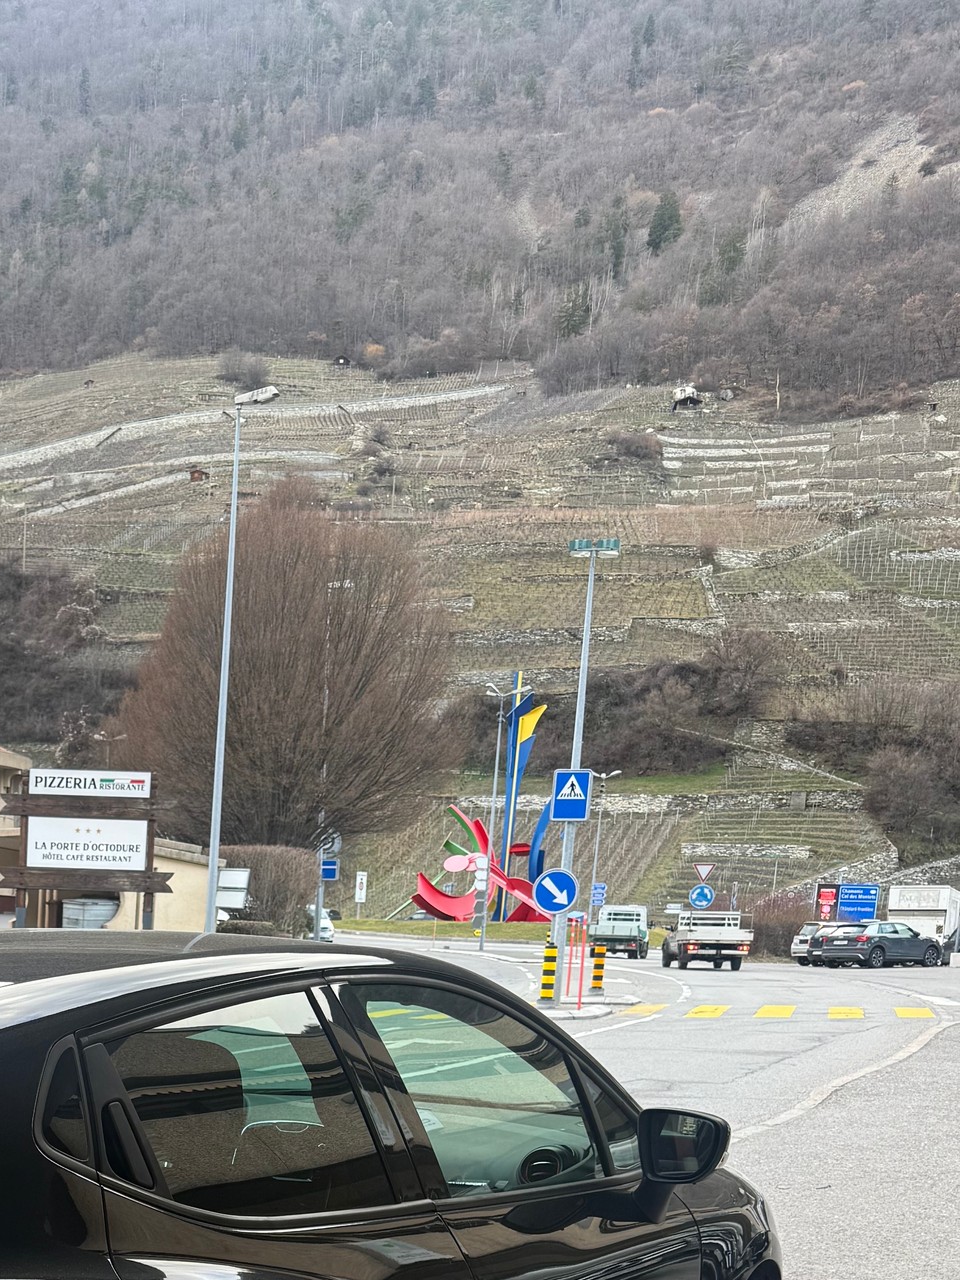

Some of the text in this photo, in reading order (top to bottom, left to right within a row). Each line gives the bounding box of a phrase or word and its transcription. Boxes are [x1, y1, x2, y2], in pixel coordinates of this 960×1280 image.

[34, 775, 146, 792] PIZZERIA RISTORANTE
[34, 841, 141, 853] LA PORTE D'OCTODURE
[42, 852, 64, 861] HÔTEL
[86, 854, 132, 863] RESTAURANT
